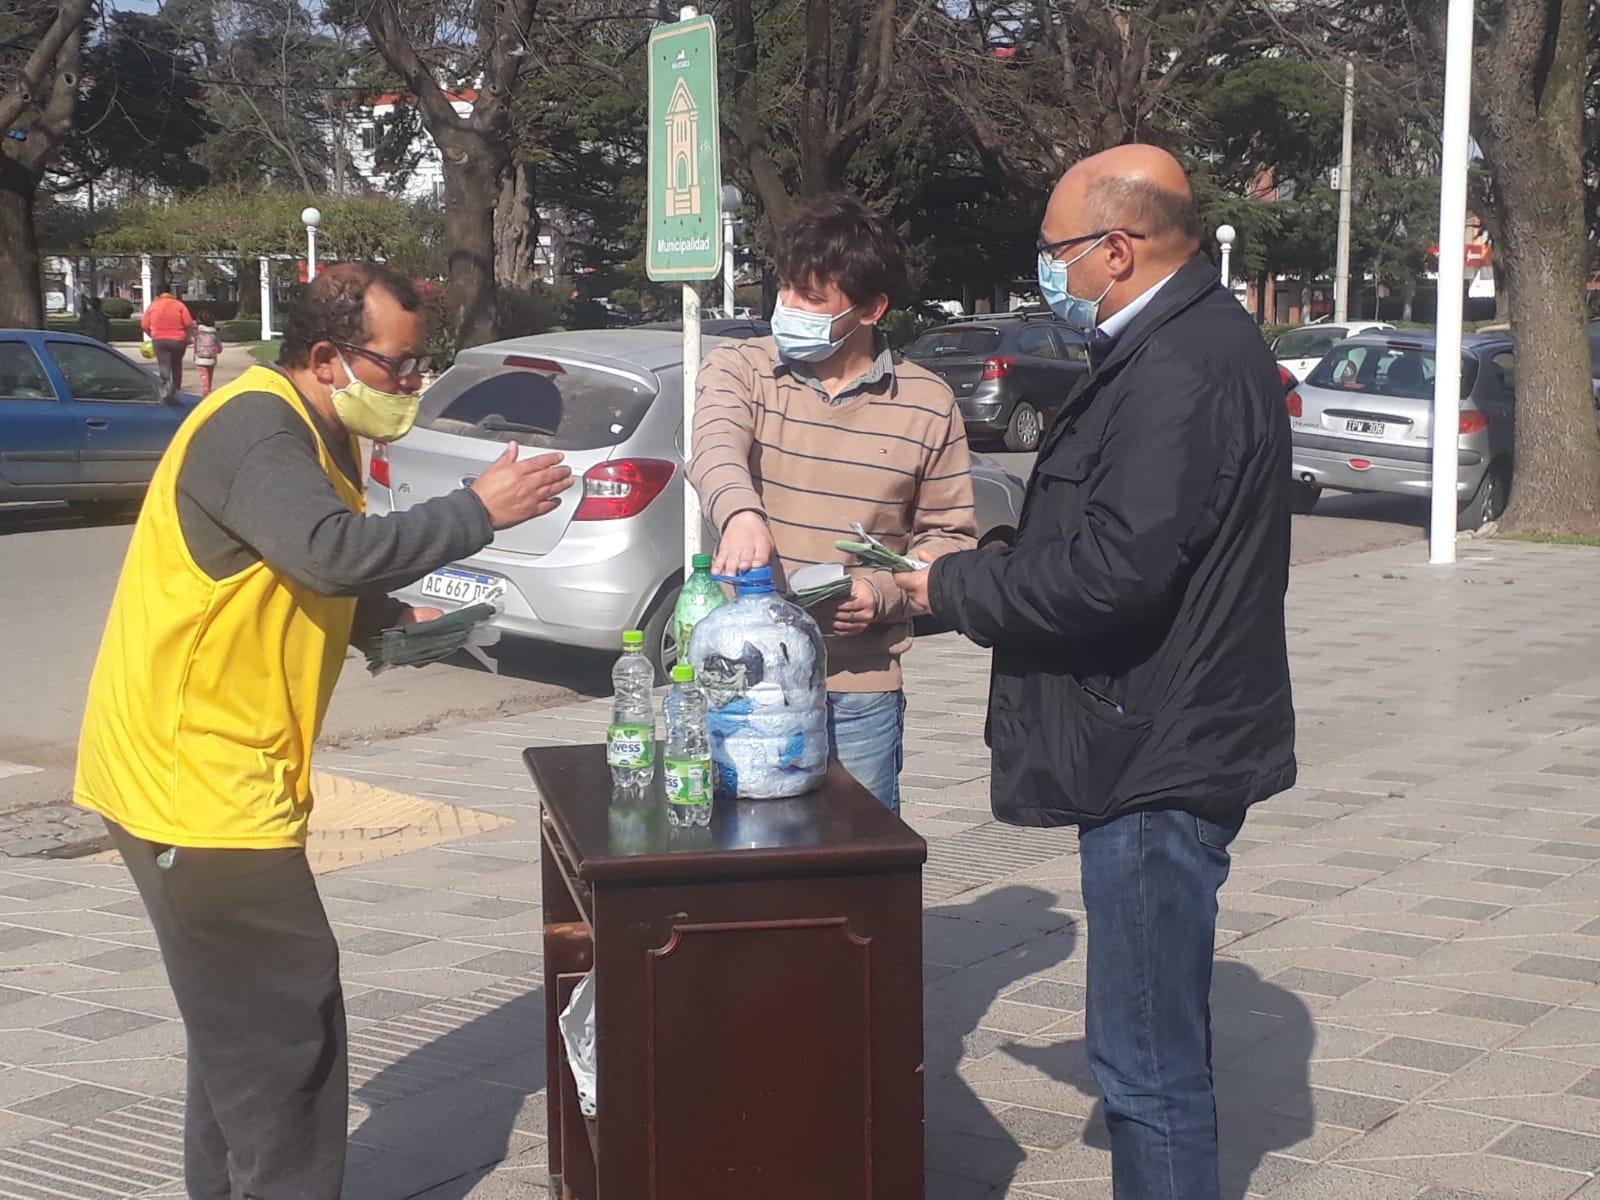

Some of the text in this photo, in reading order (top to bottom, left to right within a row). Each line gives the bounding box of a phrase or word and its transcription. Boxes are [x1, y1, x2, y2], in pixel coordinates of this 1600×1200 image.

[657, 236, 710, 255] Municipalidad
[1366, 423, 1383, 434] 306
[425, 576, 442, 593] AC
[445, 580, 470, 599] 667
